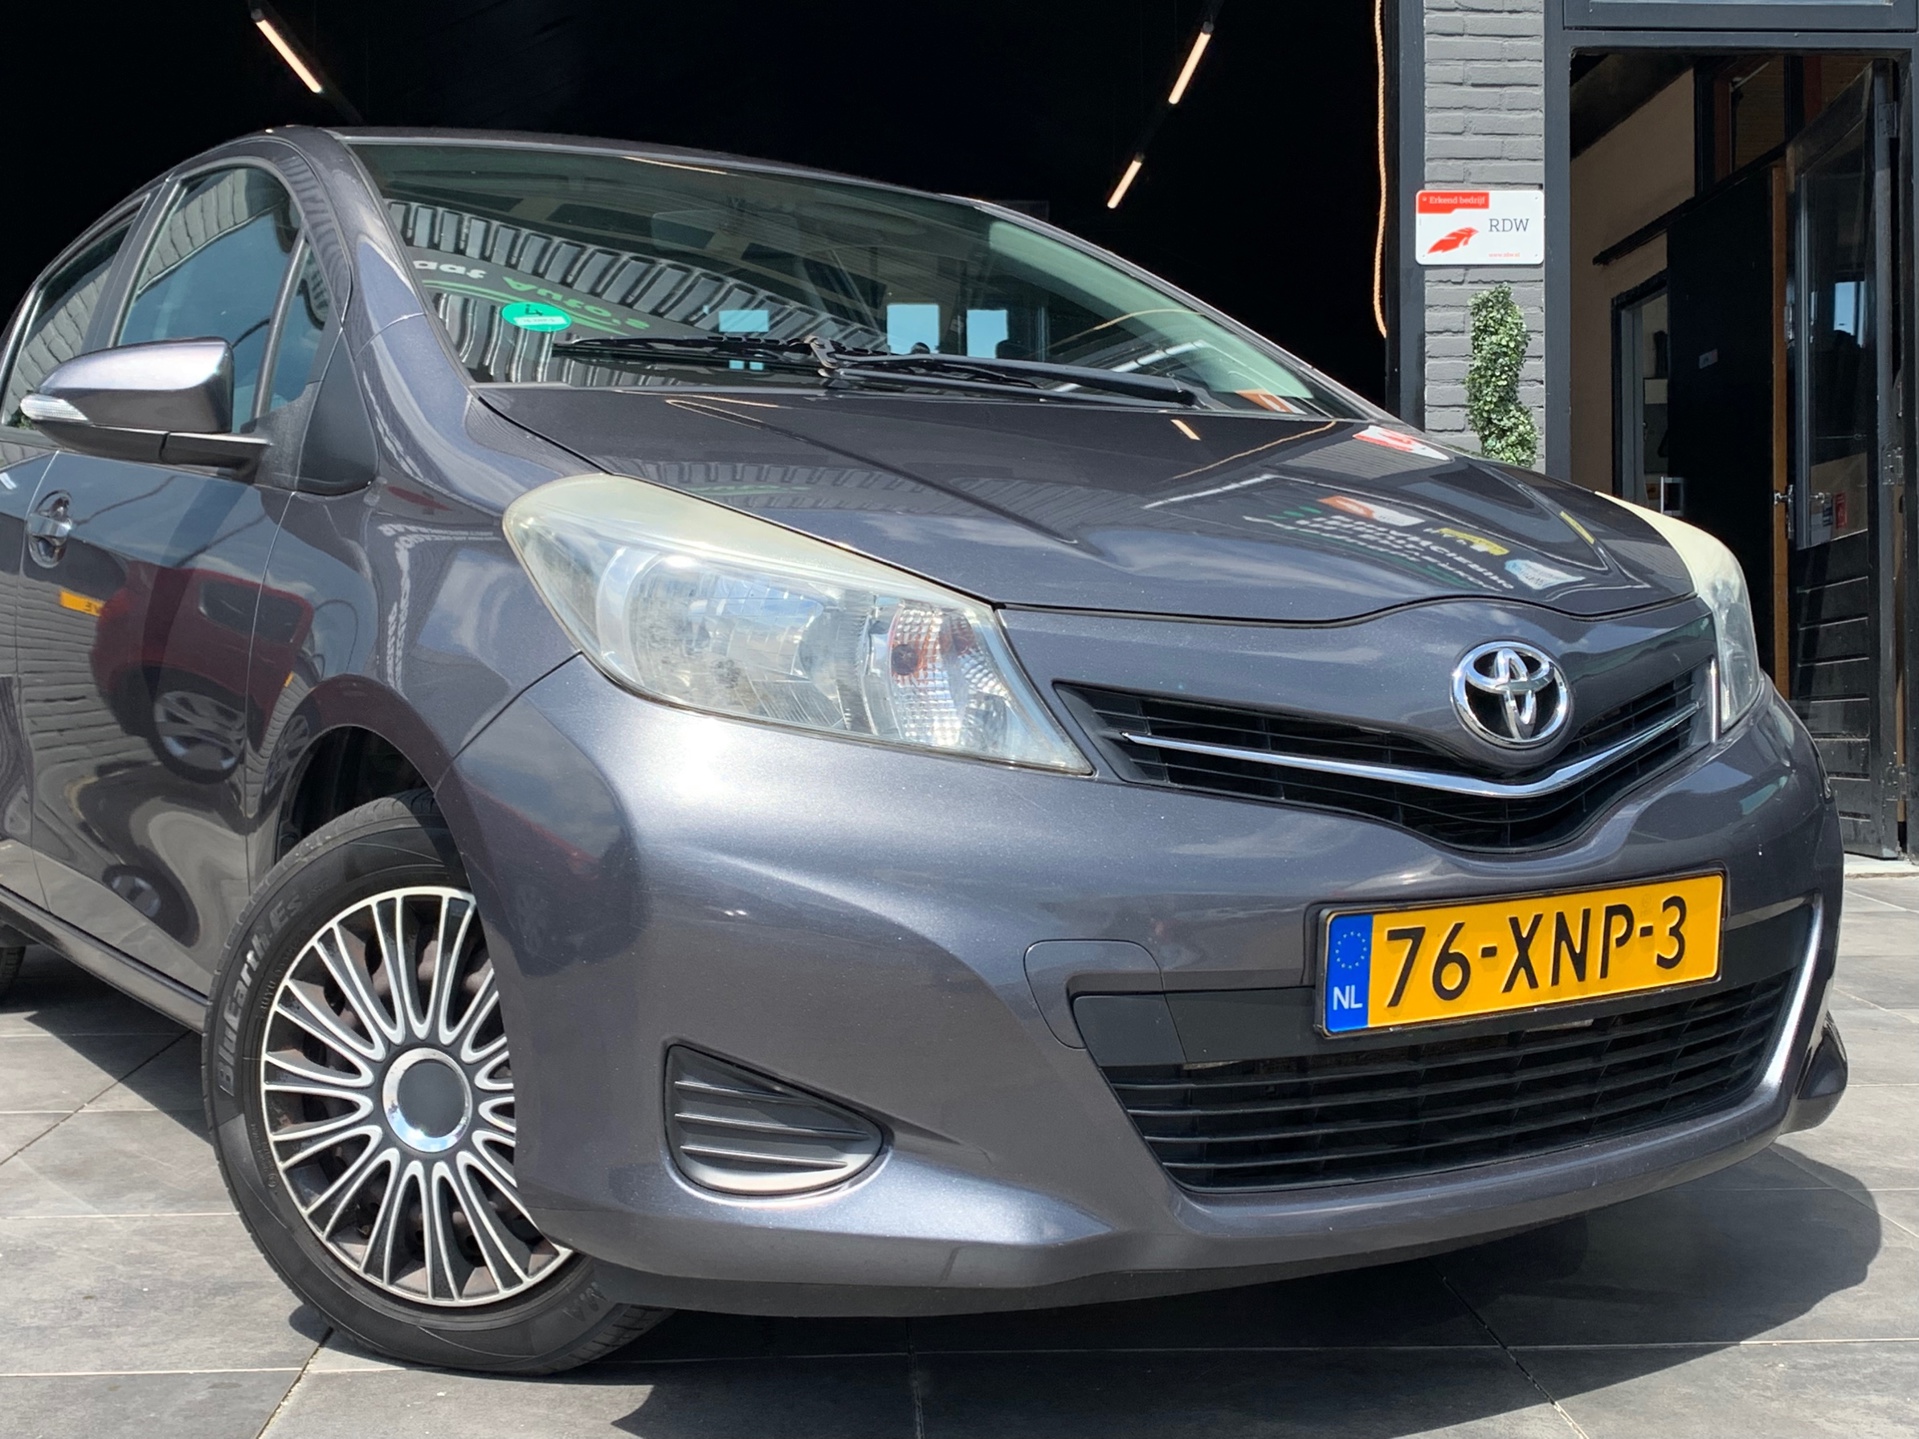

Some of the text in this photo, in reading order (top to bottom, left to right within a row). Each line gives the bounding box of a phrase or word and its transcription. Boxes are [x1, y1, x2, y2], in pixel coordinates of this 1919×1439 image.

[1429, 195, 1485, 206] Erkend bedrijf
[1488, 218, 1530, 232] RDW
[1386, 895, 1687, 1008] 76-XNP-3
[1332, 986, 1363, 1011] NL
